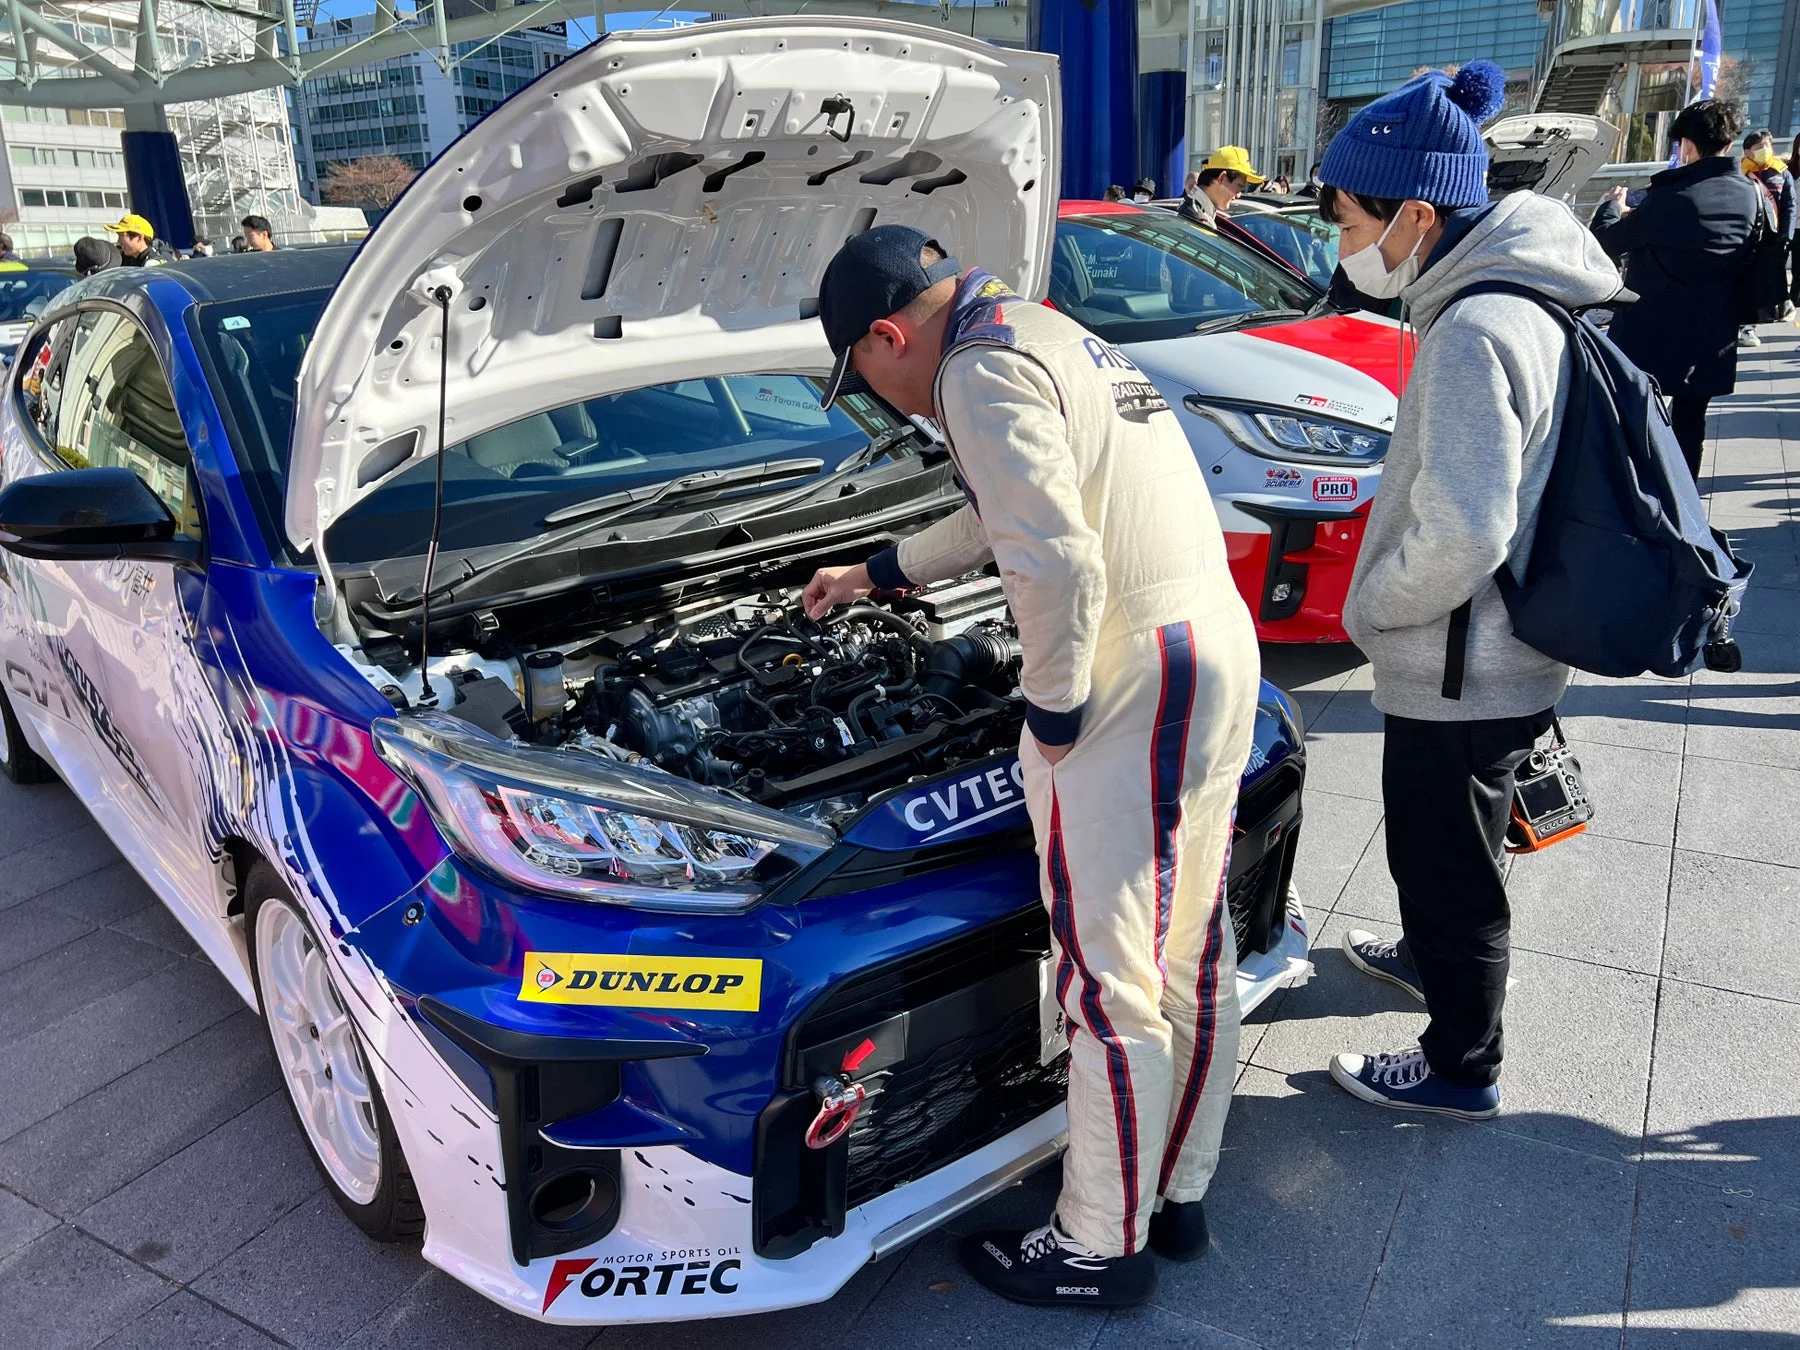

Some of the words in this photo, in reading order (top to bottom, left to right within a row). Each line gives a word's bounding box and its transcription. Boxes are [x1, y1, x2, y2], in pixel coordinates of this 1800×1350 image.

[756, 389, 772, 402] GR
[773, 395, 801, 407] TOYOTA
[802, 401, 822, 411] GAZ
[1112, 382, 1145, 400] RALLY
[1117, 401, 1134, 413] with
[1295, 395, 1327, 408] GR
[1265, 479, 1302, 488] SCUDERIA
[1321, 483, 1349, 495] PRO
[565, 970, 744, 995] DUNLOP
[602, 1253, 654, 1265] MOTOR
[660, 1248, 711, 1261] SPORTS
[717, 1246, 741, 1256] OIL
[982, 1240, 1013, 1269] sparco
[541, 1257, 742, 1316] FORTEC
[1055, 1286, 1099, 1295] sparco
